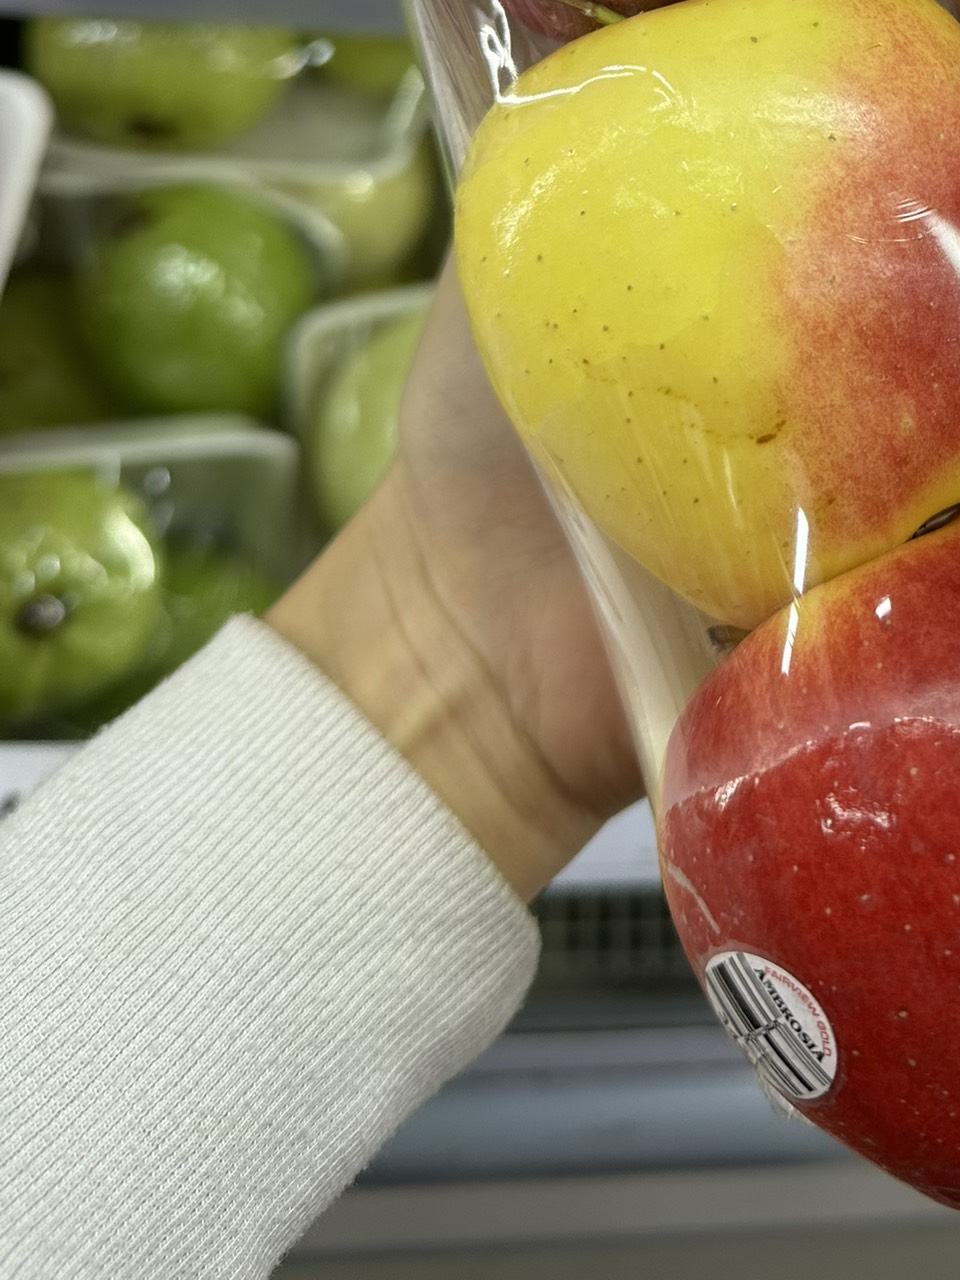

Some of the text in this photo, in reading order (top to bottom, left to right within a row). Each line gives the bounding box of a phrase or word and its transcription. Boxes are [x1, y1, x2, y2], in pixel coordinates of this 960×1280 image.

[753, 967, 826, 1064] AMBROSIA
[763, 965, 832, 1057] FAIRVIEW GOLD
